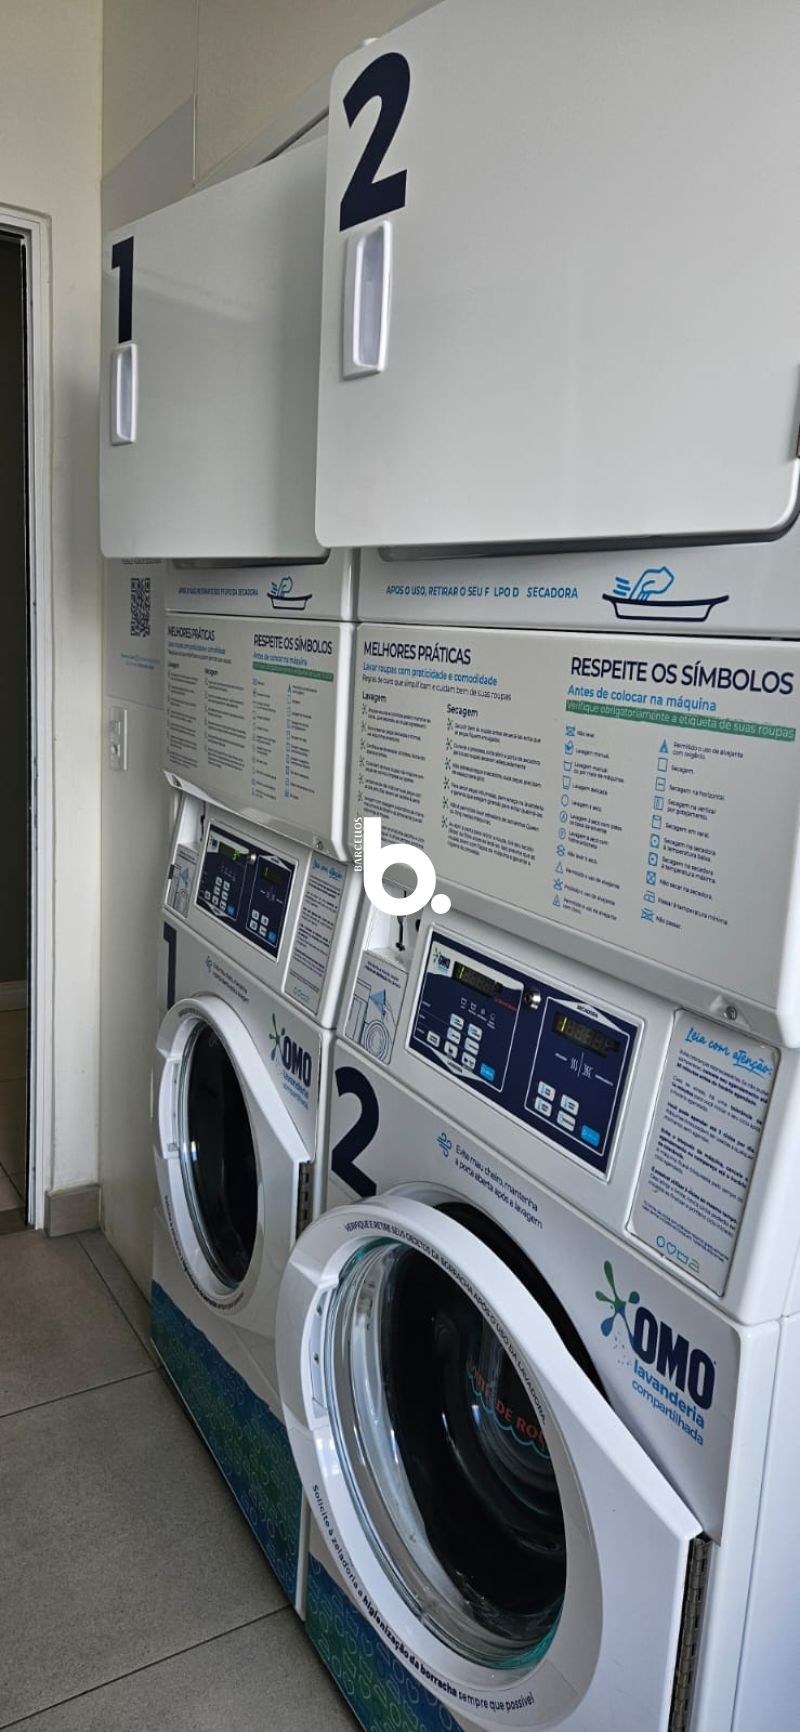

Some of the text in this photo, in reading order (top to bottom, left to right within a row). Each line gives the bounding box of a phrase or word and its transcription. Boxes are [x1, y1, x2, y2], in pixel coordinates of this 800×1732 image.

[339, 52, 410, 232] 2
[112, 236, 134, 343] 1
[428, 587, 458, 596] RETIRAR
[460, 587, 466, 596] O
[468, 587, 482, 596] SEU
[527, 587, 578, 598] SECADORA
[254, 634, 332, 655] RESPEITE OS SÍMBOLOS
[364, 641, 472, 664] MELHORES PRÁTICAS
[398, 667, 410, 675] com
[412, 668, 447, 681] praticidade
[454, 672, 498, 686] comodidade
[491, 691, 512, 702] roupas
[568, 685, 717, 712] Antes de colocar na máquina
[571, 656, 795, 695] RESPEITE OS SÍMBOLOS
[447, 703, 479, 718] Secagem
[600, 704, 670, 723] obrigatoriamente
[672, 714, 678, 722] a
[678, 714, 717, 729] etiqueta
[719, 718, 732, 730] de
[733, 722, 756, 734] suas
[758, 725, 795, 739] roupas
[164, 921, 177, 1010] 1
[282, 1035, 312, 1088] OMO
[684, 1028, 707, 1044] Leia
[708, 1040, 730, 1056] com
[331, 1067, 379, 1197] 2
[459, 1161, 474, 1178] porta
[475, 1172, 494, 1192] aberta
[494, 1188, 509, 1204] após
[515, 1203, 543, 1229] lavagem
[470, 1156, 484, 1172] mau
[485, 1165, 503, 1187] cheiro,
[504, 1182, 538, 1212] mantenha
[489, 1315, 496, 1324] O
[496, 1322, 509, 1344] USO
[508, 1344, 518, 1361] DA
[633, 1306, 716, 1410] OMO
[496, 1399, 513, 1422] DE
[632, 1380, 704, 1446] compartilhada
[633, 1360, 704, 1429] lavanderia
[312, 1484, 330, 1528] Solicite
[332, 1538, 358, 1589] zeladoria
[363, 1595, 409, 1658] higienização
[409, 1656, 419, 1670] da
[420, 1665, 457, 1697] borracha
[458, 1691, 488, 1709] sempre
[489, 1700, 505, 1712] que
[505, 1691, 535, 1714] possível
